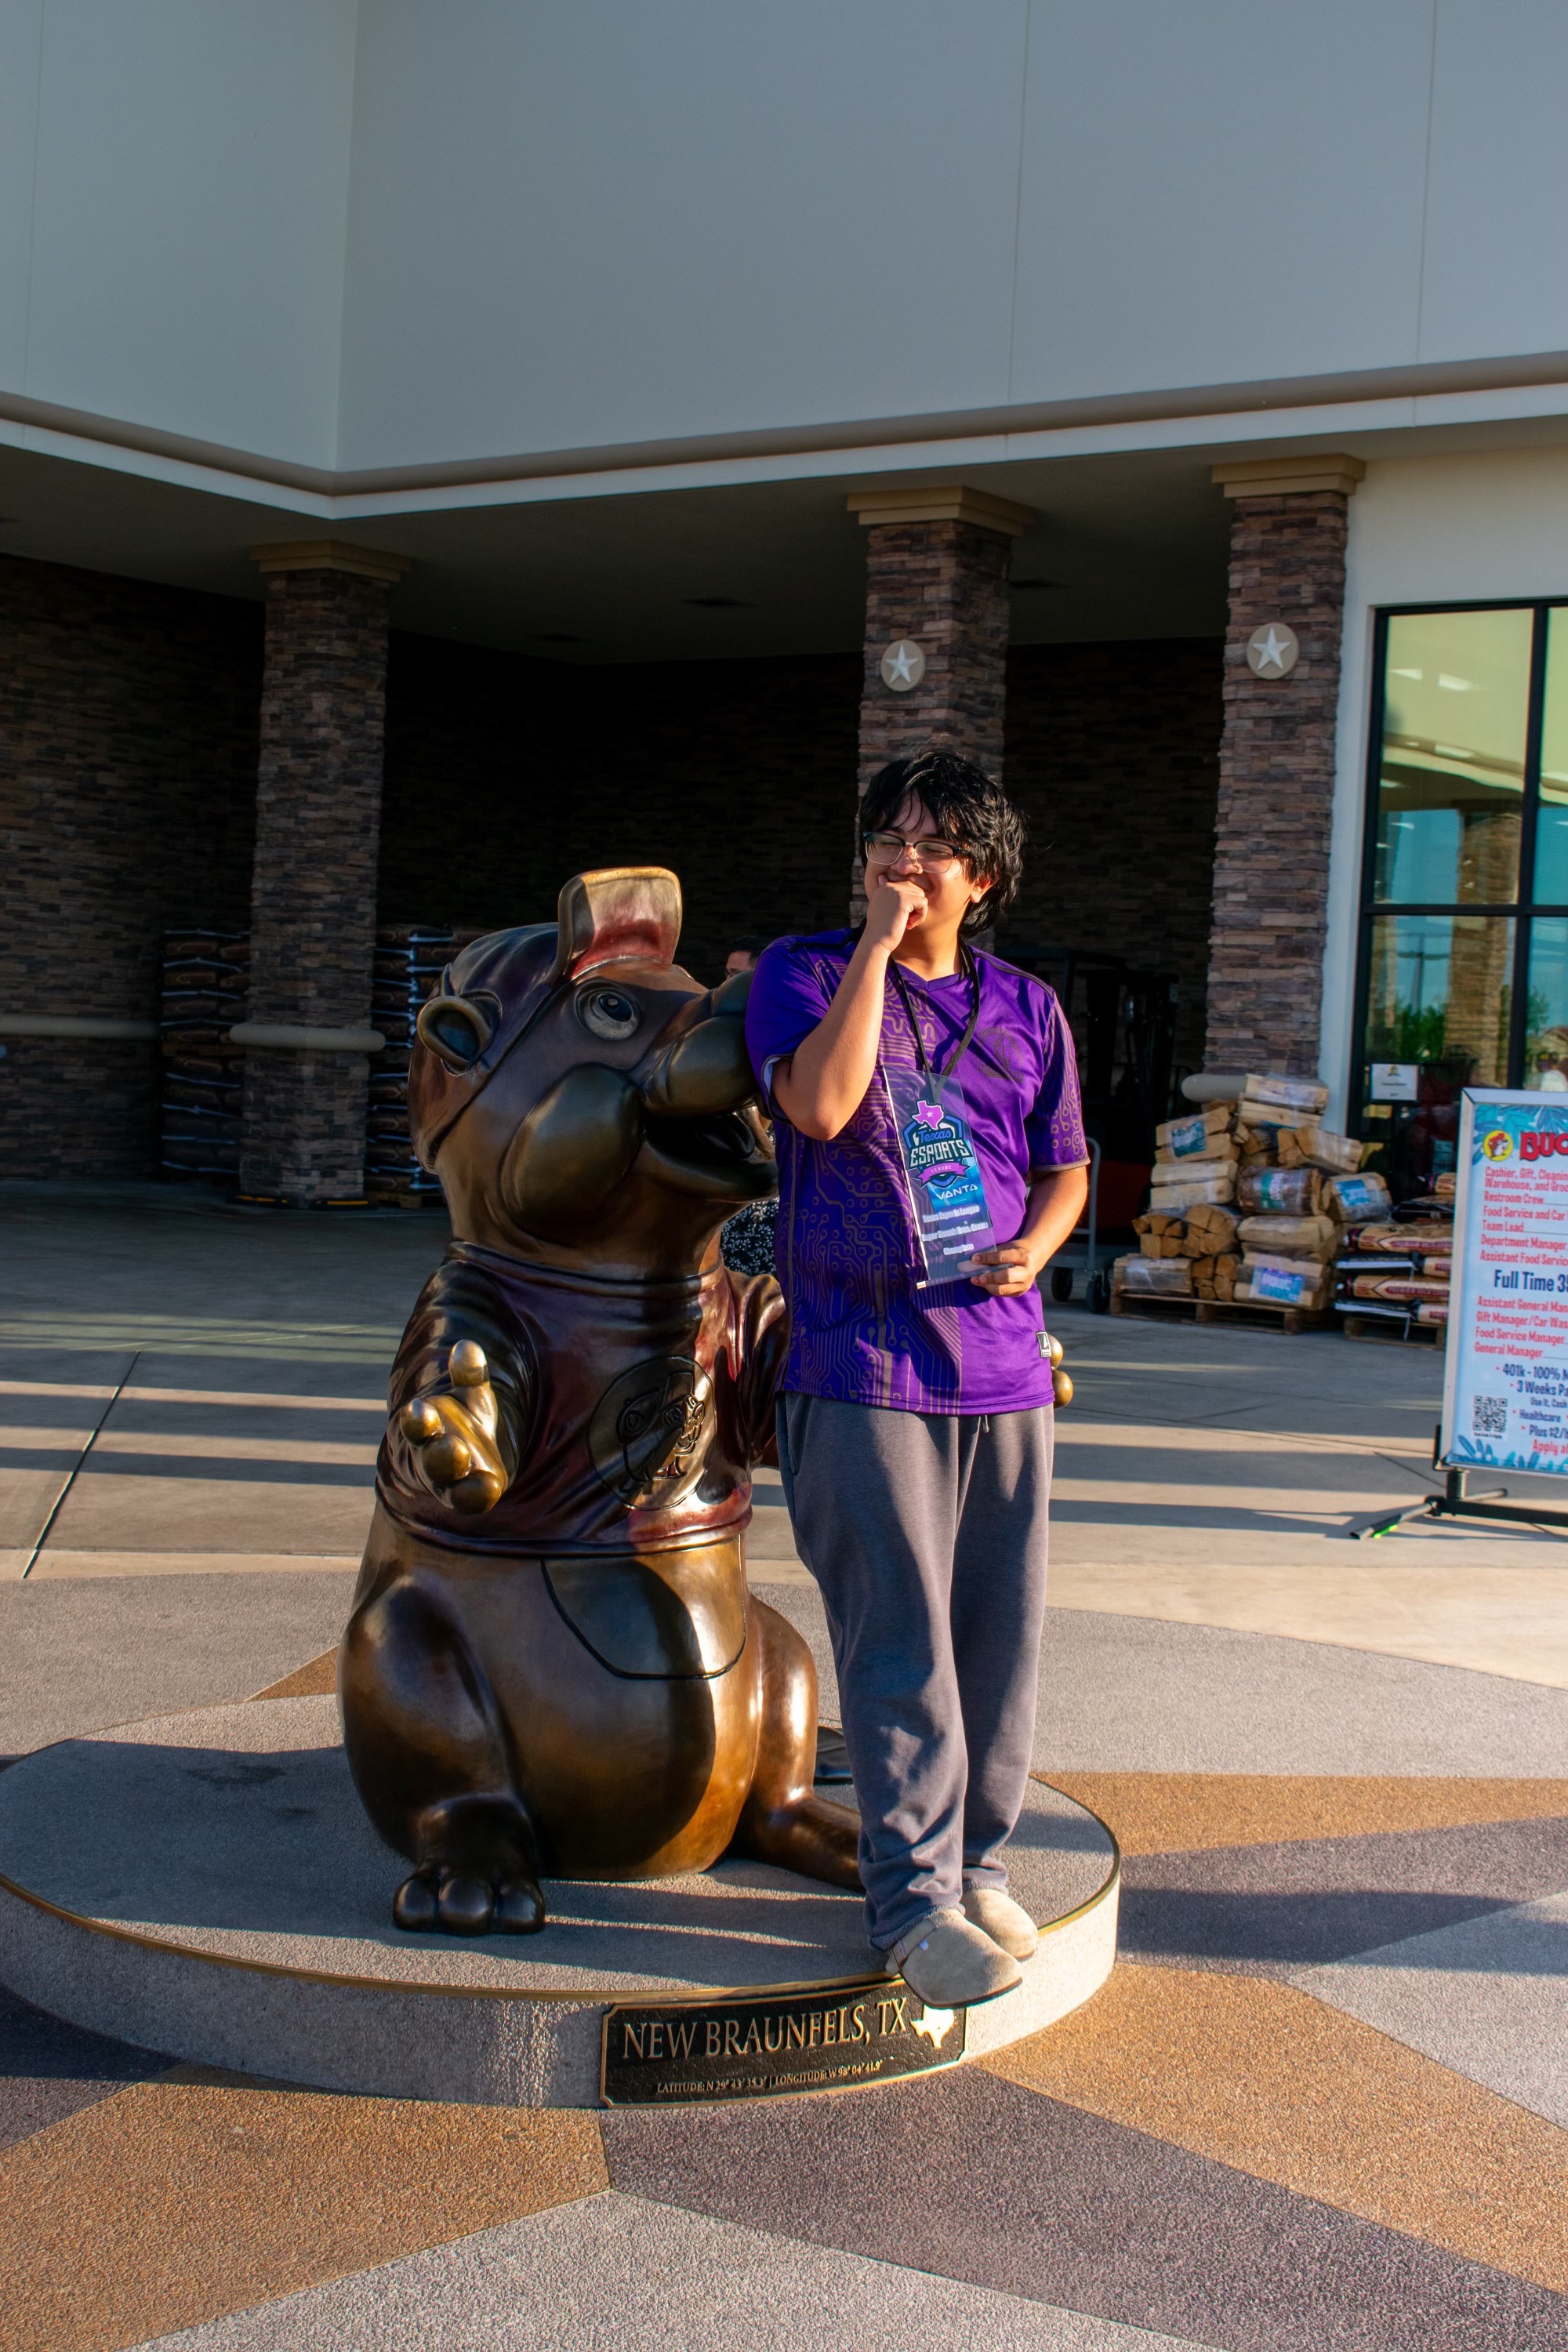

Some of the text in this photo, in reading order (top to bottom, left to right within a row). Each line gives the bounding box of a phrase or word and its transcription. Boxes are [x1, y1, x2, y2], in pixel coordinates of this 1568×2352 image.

[918, 1130, 951, 1143] Texas
[910, 1139, 970, 1167] ESPORTS
[1485, 1167, 1518, 1180] Cashier,
[1519, 1168, 1537, 1180] Gift,
[935, 1184, 978, 1200] VANTA
[1485, 1178, 1532, 1192] Warehouse,
[1534, 1181, 1549, 1191] and
[1483, 1190, 1544, 1204] Restroom Crew
[1483, 1205, 1502, 1217] Food
[1504, 1207, 1533, 1218] Service
[1534, 1210, 1550, 1220] and
[1552, 1210, 1565, 1221] Car
[1482, 1220, 1524, 1232] Team Lead
[1480, 1234, 1566, 1253] Department Manager
[1480, 1250, 1519, 1263] Assistant
[1520, 1252, 1540, 1264] Food
[1494, 1269, 1568, 1293] Full Time 3
[1477, 1295, 1515, 1308] Assistant
[1517, 1298, 1548, 1312] General
[1476, 1311, 1490, 1323] Gift
[1475, 1327, 1565, 1346] Food Service Manager
[1475, 1341, 1543, 1359] General Manager
[1503, 1363, 1525, 1377] 401k
[1534, 1366, 1561, 1380] 100%
[1517, 1380, 1523, 1392] 3
[1525, 1381, 1556, 1396] Weeks
[1519, 1409, 1561, 1423] Healthcare
[1529, 1425, 1547, 1437] Plus
[1532, 1439, 1559, 1455] Apply
[622, 1998, 908, 2060] NEW BRAUNFELS, TX
[657, 2081, 706, 2093] LATITUDE:
[706, 2080, 714, 2091] N
[775, 2069, 828, 2085] LONGITUDE:
[829, 2067, 837, 2078] W
